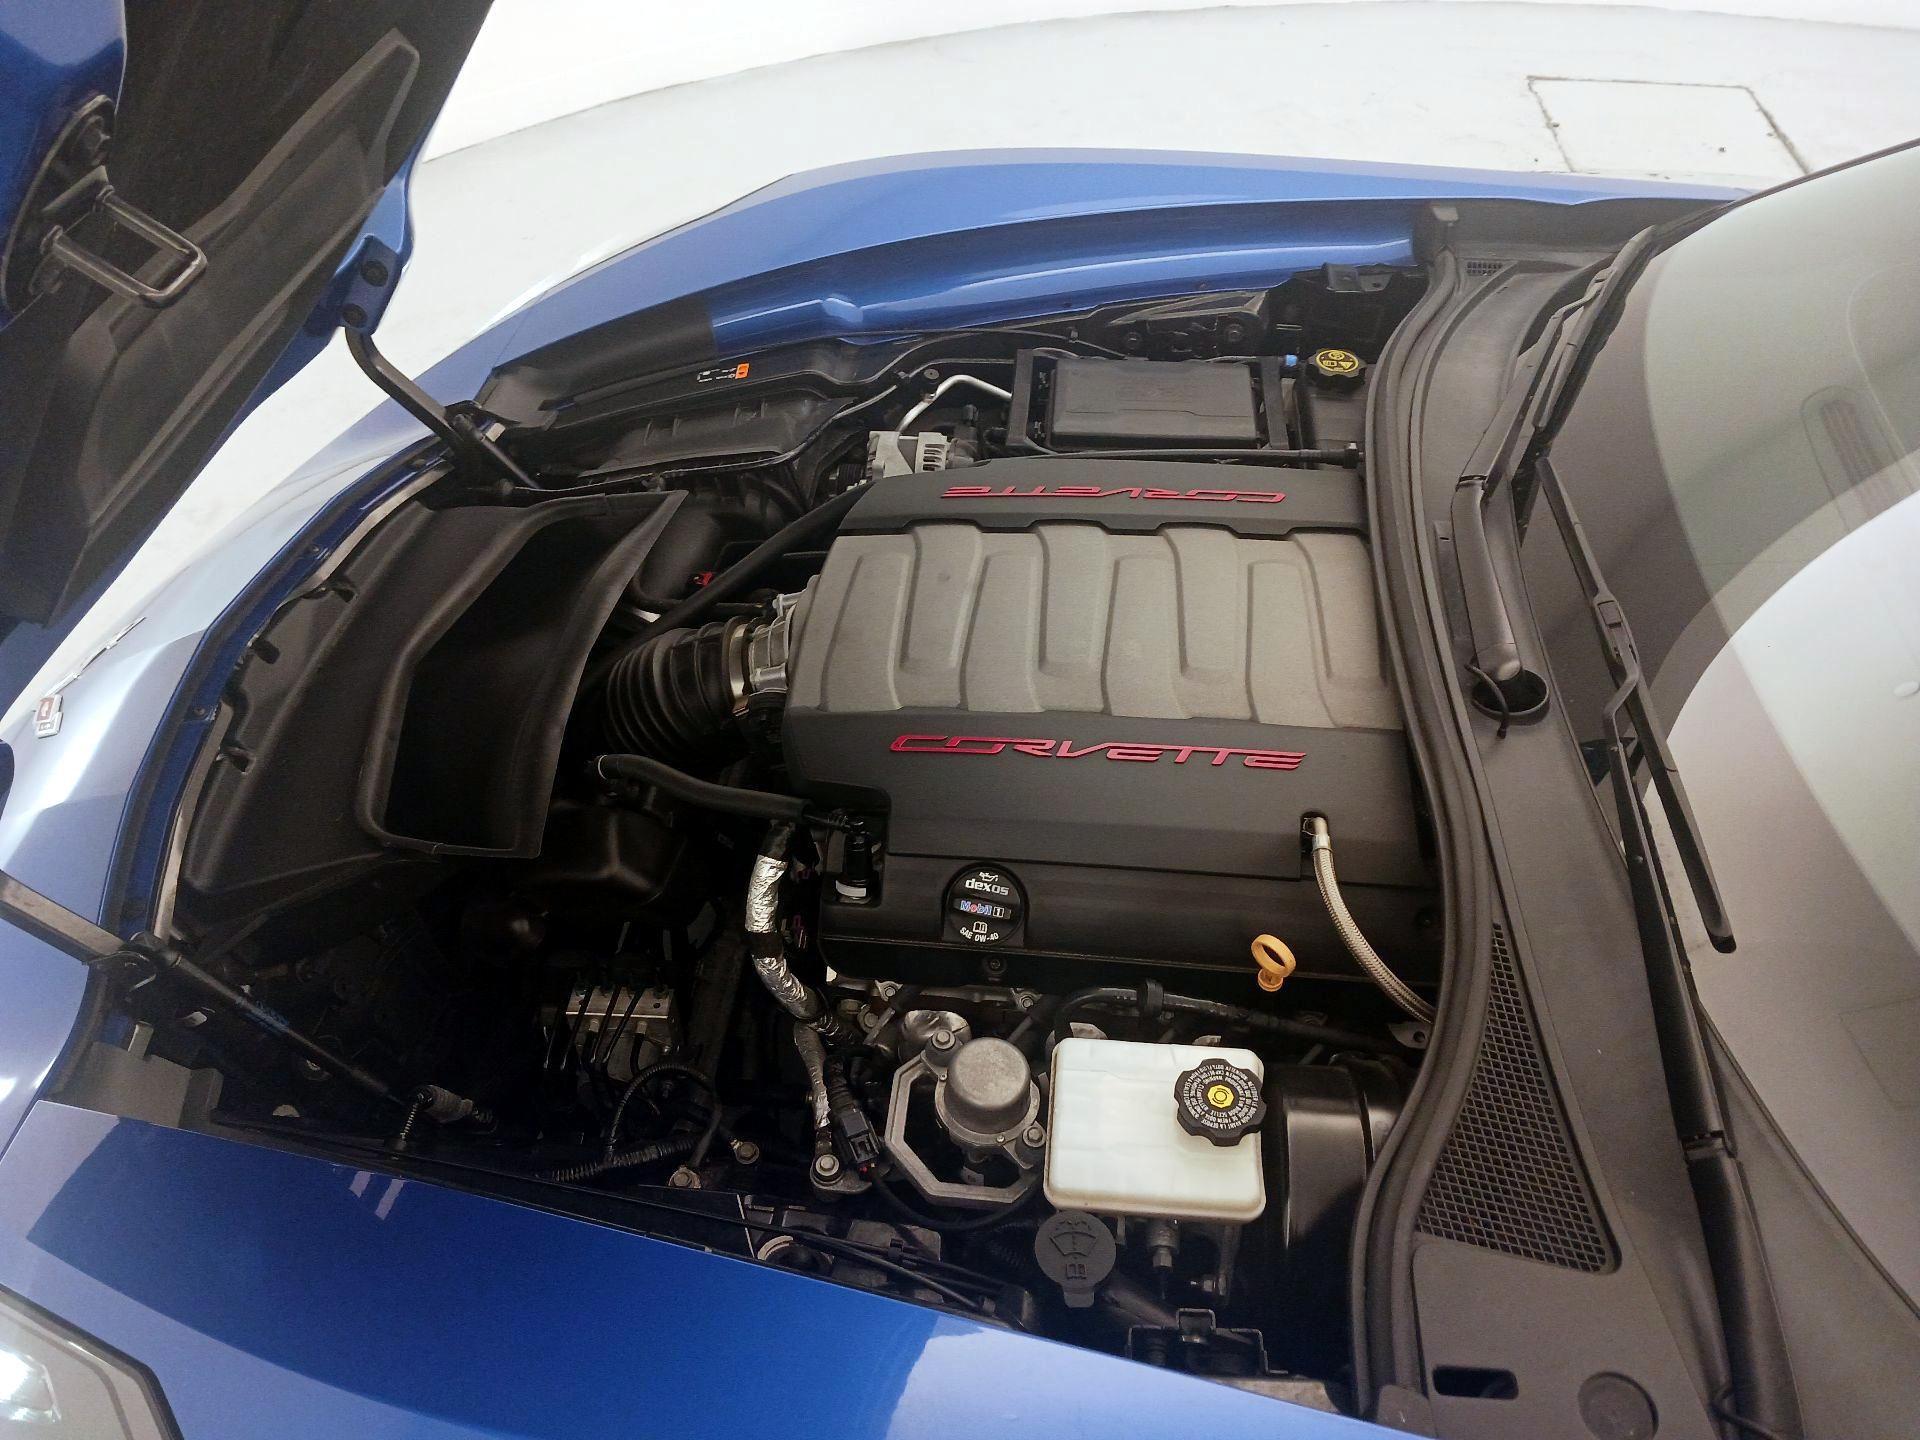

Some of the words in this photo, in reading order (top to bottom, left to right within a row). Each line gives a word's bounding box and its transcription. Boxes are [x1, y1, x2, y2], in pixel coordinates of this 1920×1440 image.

[941, 484, 1287, 504] CORVETTE
[889, 733, 1307, 771] CORVETTE
[965, 878, 1010, 896] dexos
[960, 900, 993, 916] Mobil
[959, 926, 974, 939] SAE
